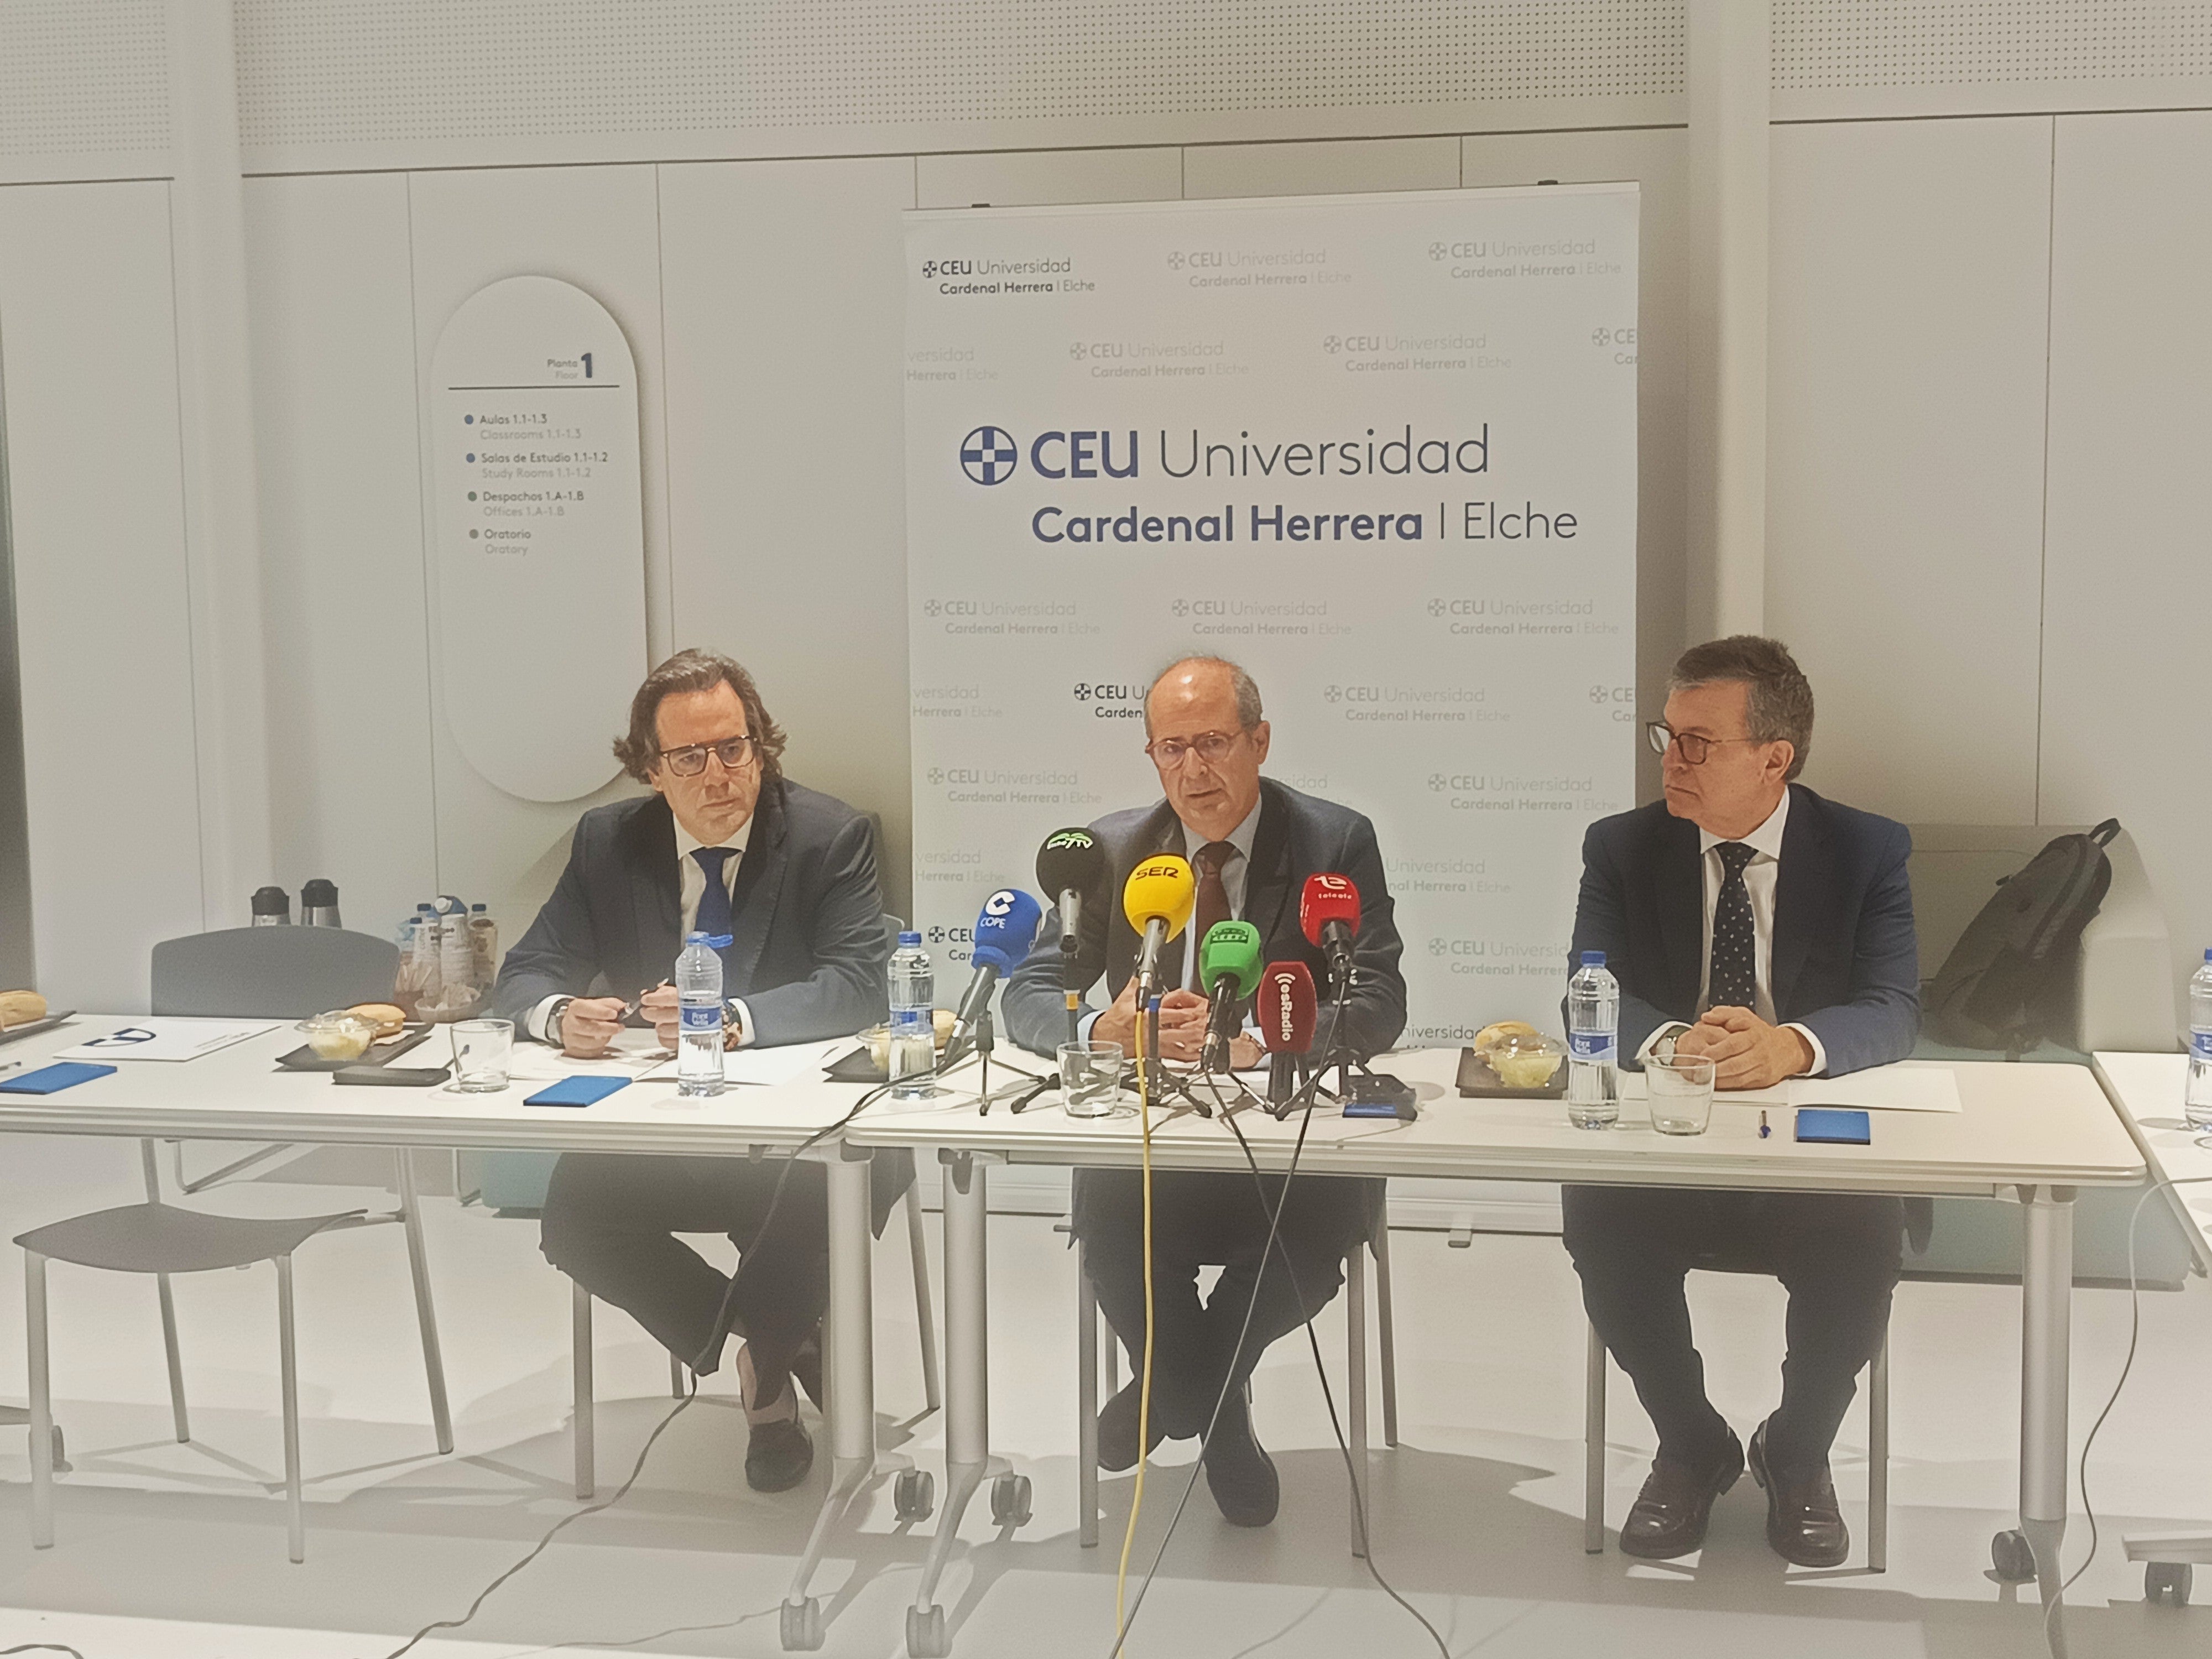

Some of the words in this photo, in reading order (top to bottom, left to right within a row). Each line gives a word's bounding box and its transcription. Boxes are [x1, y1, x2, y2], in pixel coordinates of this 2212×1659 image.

[1451, 242, 1486, 258] CEU
[1492, 238, 1595, 257] Universidad
[1189, 252, 1222, 268] CEU
[1228, 248, 1327, 267] Universidad
[940, 260, 972, 275] CEU
[977, 257, 1071, 275] Universidad
[1451, 265, 1516, 279] Cardenal
[1521, 264, 1575, 276] Herrera
[1587, 262, 1621, 275] Elche
[1189, 274, 1251, 288] Cardenal
[1255, 274, 1307, 285] Herrera
[1318, 271, 1352, 284] Elche
[940, 283, 1000, 295] Cardenal
[1005, 283, 1053, 293] Herrera
[1063, 279, 1095, 292] Elche
[1091, 343, 1123, 358] CEU
[1128, 340, 1224, 358] Universidad
[1345, 336, 1380, 352] CEU
[1385, 333, 1486, 351] Universidad
[547, 359, 577, 368] Planta
[581, 353, 592, 378] 1
[1091, 366, 1151, 378] Cardenal
[1155, 364, 1205, 376] Herrera
[1215, 363, 1249, 375] Elche
[1345, 358, 1408, 372] Cardenal
[1413, 358, 1466, 370] Herrera
[1477, 356, 1511, 368] Elche
[907, 370, 956, 380] Herrera
[966, 368, 999, 380] Elche
[480, 415, 510, 424] Aulas
[513, 413, 547, 424] 1.1-1.3
[547, 428, 581, 439] 1.1-1.3
[481, 453, 510, 463] Salas
[513, 454, 526, 463] de
[530, 452, 571, 463] Estudio
[574, 452, 608, 462] 1.1-1.2
[1031, 430, 1138, 479] CEU
[1161, 423, 1488, 477] Universidad
[557, 467, 591, 478] 1.1-1.2
[483, 491, 542, 503] Despachos
[546, 491, 584, 500] 1.A-1.B
[526, 505, 565, 516] 1.A-1.B
[1032, 505, 1233, 542] Cardenal
[1251, 505, 1422, 541] Herrera
[1465, 501, 1577, 539] Elche
[484, 529, 531, 539] Oratorio
[945, 601, 977, 615] CEU
[982, 601, 1076, 616] Universidad
[1192, 601, 1225, 615] CEU
[1230, 601, 1327, 616] Universidad
[1450, 599, 1485, 615] CEU
[1490, 598, 1593, 615] Universidad
[945, 623, 1004, 634] Cardenal
[1008, 623, 1058, 634] Herrera
[1068, 622, 1100, 634] Elche
[1192, 623, 1253, 634] Cardenal
[1258, 623, 1308, 635] Herrera
[1318, 622, 1352, 635] Elche
[1450, 623, 1514, 635] Cardenal
[1519, 623, 1573, 634] Herrera
[1584, 622, 1619, 634] Elche
[1095, 685, 1126, 699] CEU
[1345, 687, 1379, 702] CEU
[1385, 687, 1485, 702] Universidad
[913, 706, 962, 717] Herrera
[972, 706, 1003, 718] Elche
[1345, 709, 1408, 721] Cardenal
[1413, 709, 1465, 721] Herrera
[1477, 709, 1511, 722] Elche
[947, 769, 979, 784] CEU
[984, 770, 1078, 785] Universidad
[1451, 775, 1484, 790] CEU
[1490, 776, 1593, 792] Universidad
[947, 791, 1006, 802] Cardenal
[1010, 791, 1060, 803] Herrera
[1070, 791, 1102, 804] Elche
[1451, 797, 1514, 811] Cardenal
[1519, 799, 1572, 810] Herrera
[1583, 798, 1619, 811] Elche
[1386, 858, 1486, 874] Universidad
[916, 870, 963, 881] Herrera
[974, 872, 1004, 882] Elche
[1136, 867, 1179, 880] SER
[1414, 880, 1466, 892] Herrera
[1477, 880, 1512, 894] Elche
[980, 917, 1006, 929] COPE
[1451, 940, 1484, 956] CEU
[1451, 962, 1514, 975] Cardenal
